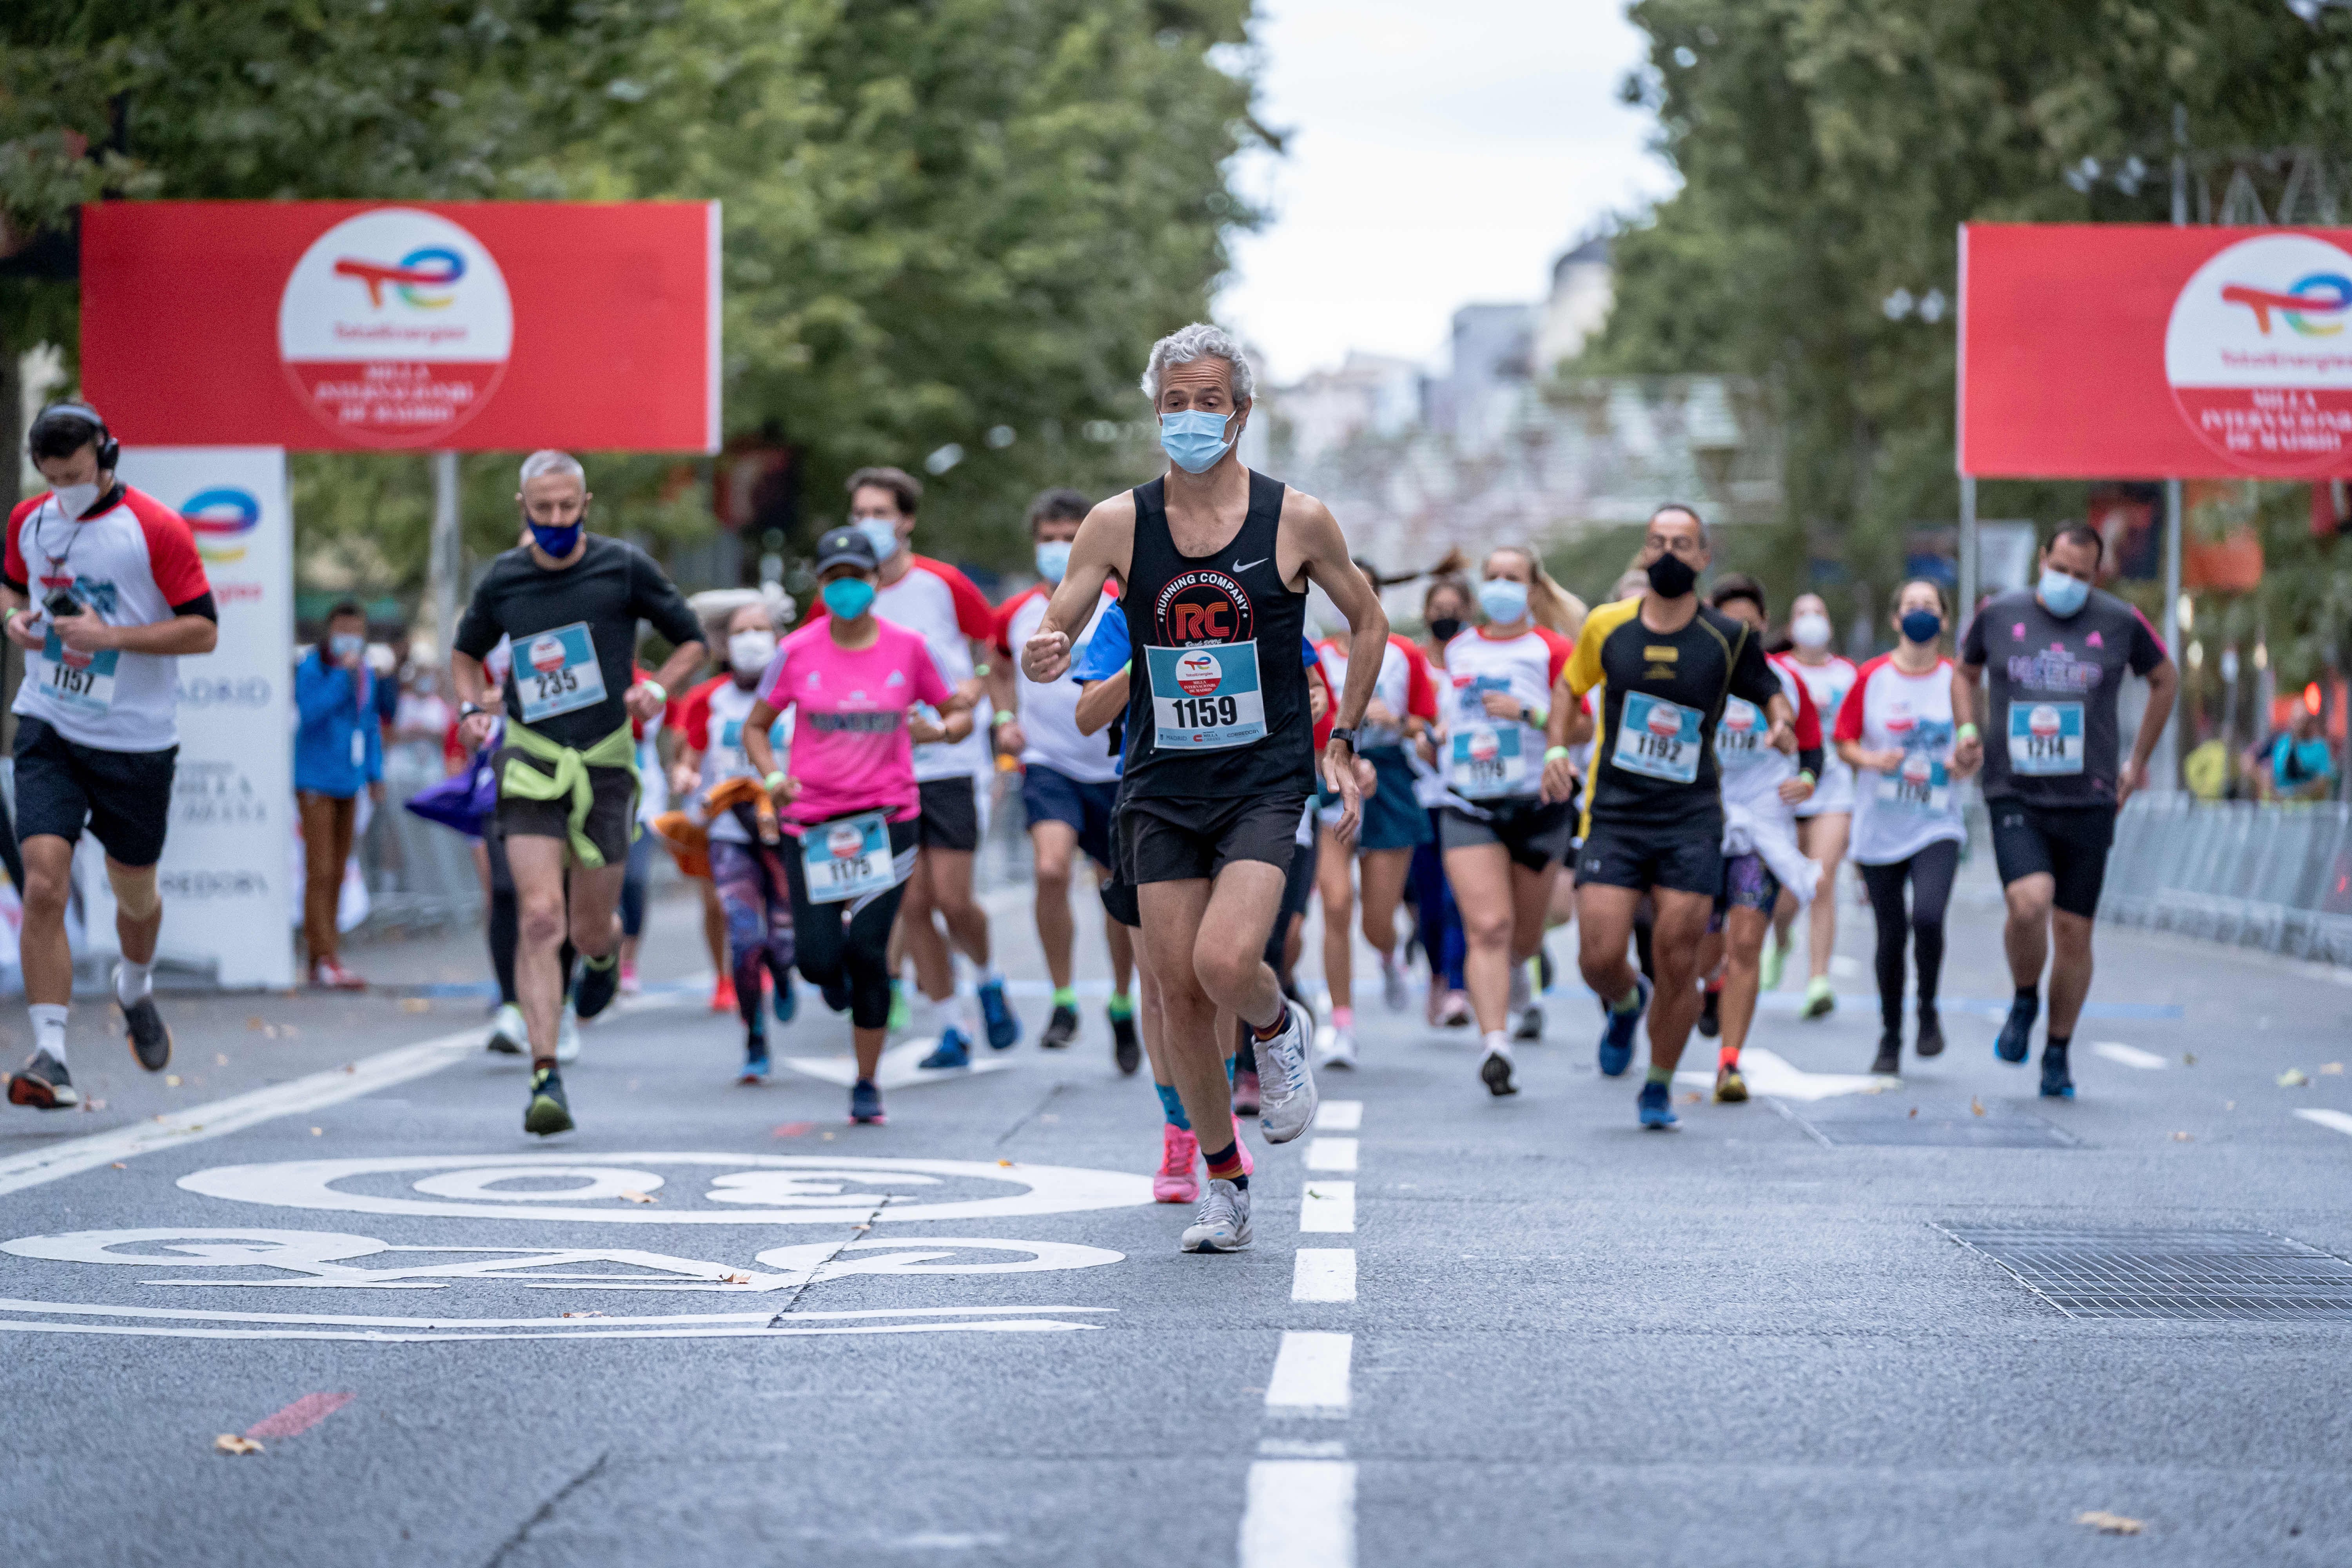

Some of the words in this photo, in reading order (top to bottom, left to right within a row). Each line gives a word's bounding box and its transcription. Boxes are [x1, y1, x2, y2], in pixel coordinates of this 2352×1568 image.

[1157, 574, 1196, 616] RUNNING
[1200, 573, 1249, 610] COMPANY
[1175, 602, 1230, 639] RC
[53, 666, 95, 695] 1157
[535, 668, 578, 699] 235
[1172, 696, 1238, 728] 1159
[1638, 734, 1682, 763] 1192
